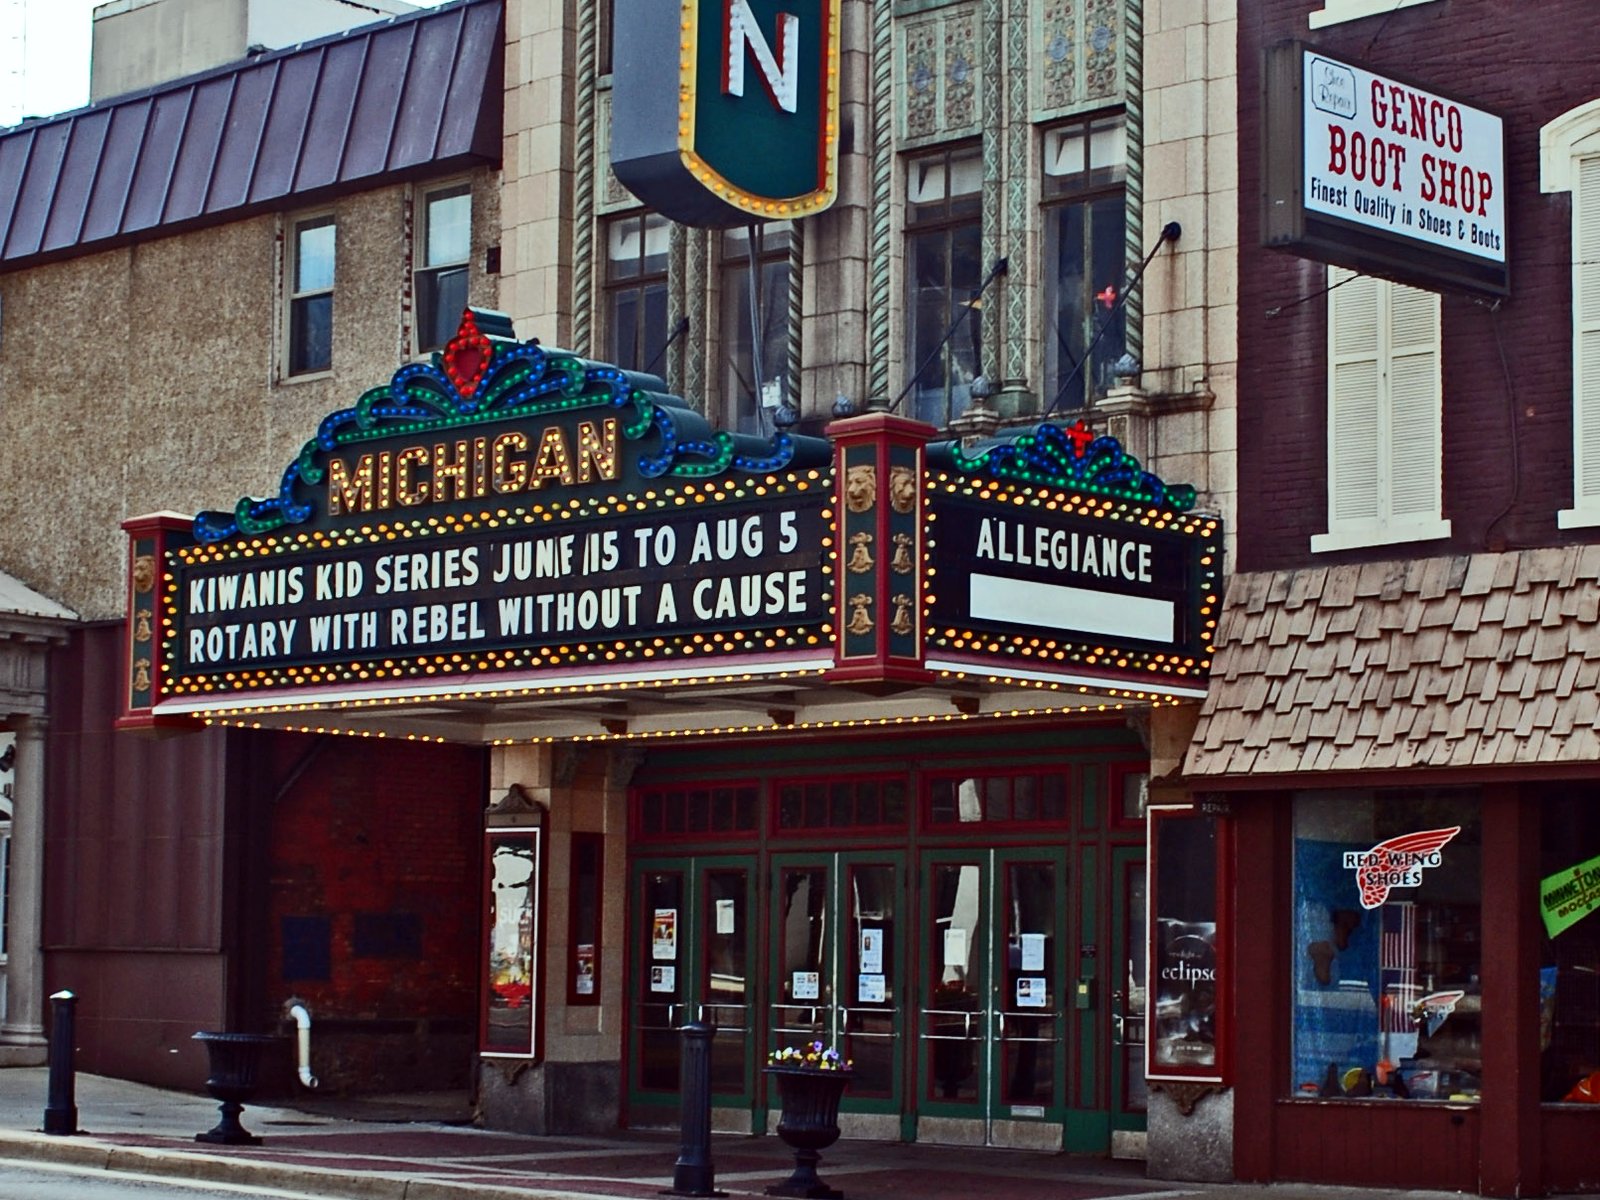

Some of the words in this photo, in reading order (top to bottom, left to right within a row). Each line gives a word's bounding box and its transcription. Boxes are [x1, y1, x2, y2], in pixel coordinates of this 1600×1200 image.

[721, 0, 799, 114] N
[1371, 79, 1463, 153] GENCO
[1328, 123, 1406, 192] BOOT
[1421, 153, 1493, 217] SHOP
[1311, 177, 1347, 207] Finest
[1354, 189, 1396, 225] Quality
[1402, 204, 1412, 227] in
[1419, 208, 1451, 237] Shoes
[1458, 219, 1465, 240] &
[1471, 223, 1501, 251] Boots
[328, 417, 617, 517] MICHIGAN
[190, 566, 304, 614] KIWANIS
[315, 561, 364, 601] KID
[375, 547, 479, 595] SERIES
[493, 534, 575, 582] JUNE
[634, 525, 676, 568] TO
[690, 515, 764, 564] AUG
[779, 511, 798, 554] 5
[976, 518, 1152, 582] ALLEGIANCE
[190, 619, 297, 664] ROTARY
[310, 611, 378, 653] WITH
[391, 602, 485, 645] REBEL
[498, 586, 642, 637] WITHOUT
[656, 583, 677, 624] A
[692, 570, 807, 621] CAUSE
[1346, 853, 1379, 867] RED
[1388, 852, 1440, 866] WING
[1366, 871, 1421, 885] SHOES
